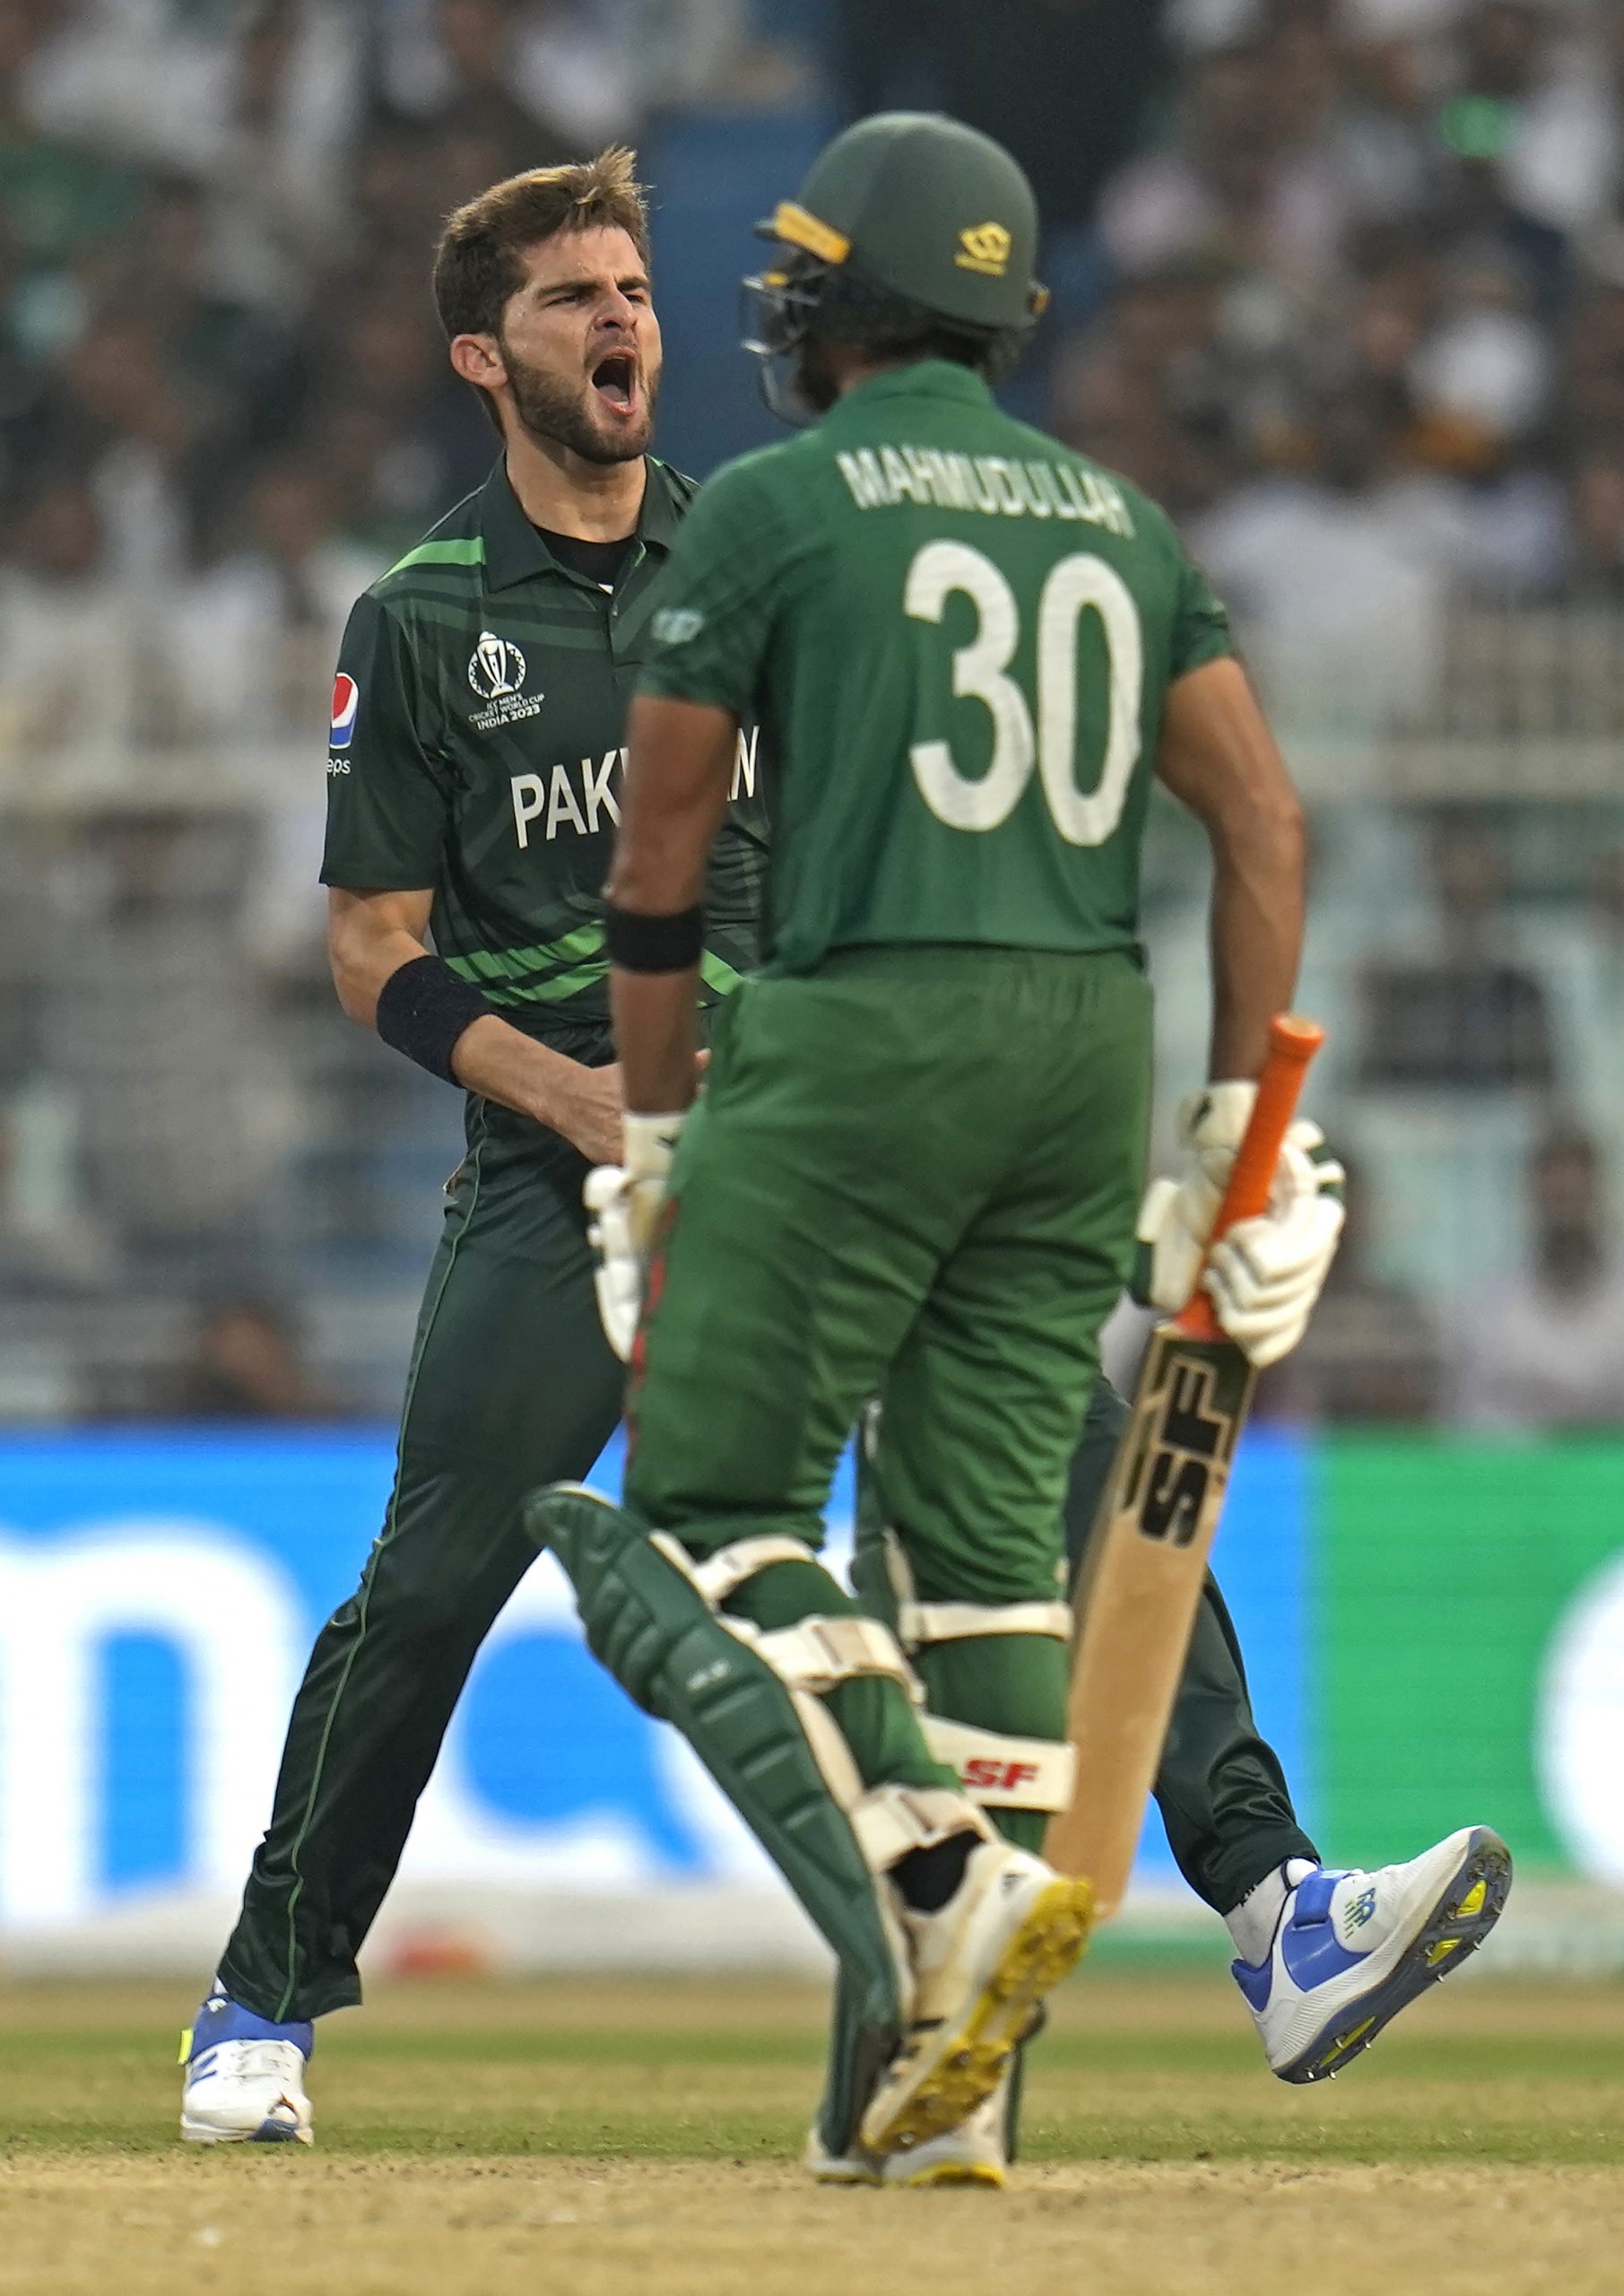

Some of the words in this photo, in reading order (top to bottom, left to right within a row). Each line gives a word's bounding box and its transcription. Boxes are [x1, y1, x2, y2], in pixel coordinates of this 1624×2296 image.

[836, 443, 1136, 540] MAHMUDULLAH
[477, 714, 510, 730] INDIA
[509, 704, 541, 721] 2023
[499, 700, 529, 714] WORLD
[528, 692, 545, 705] CUP
[903, 538, 1143, 848] 30
[1139, 1364, 1221, 1549] SF
[961, 1758, 1041, 1791] SF
